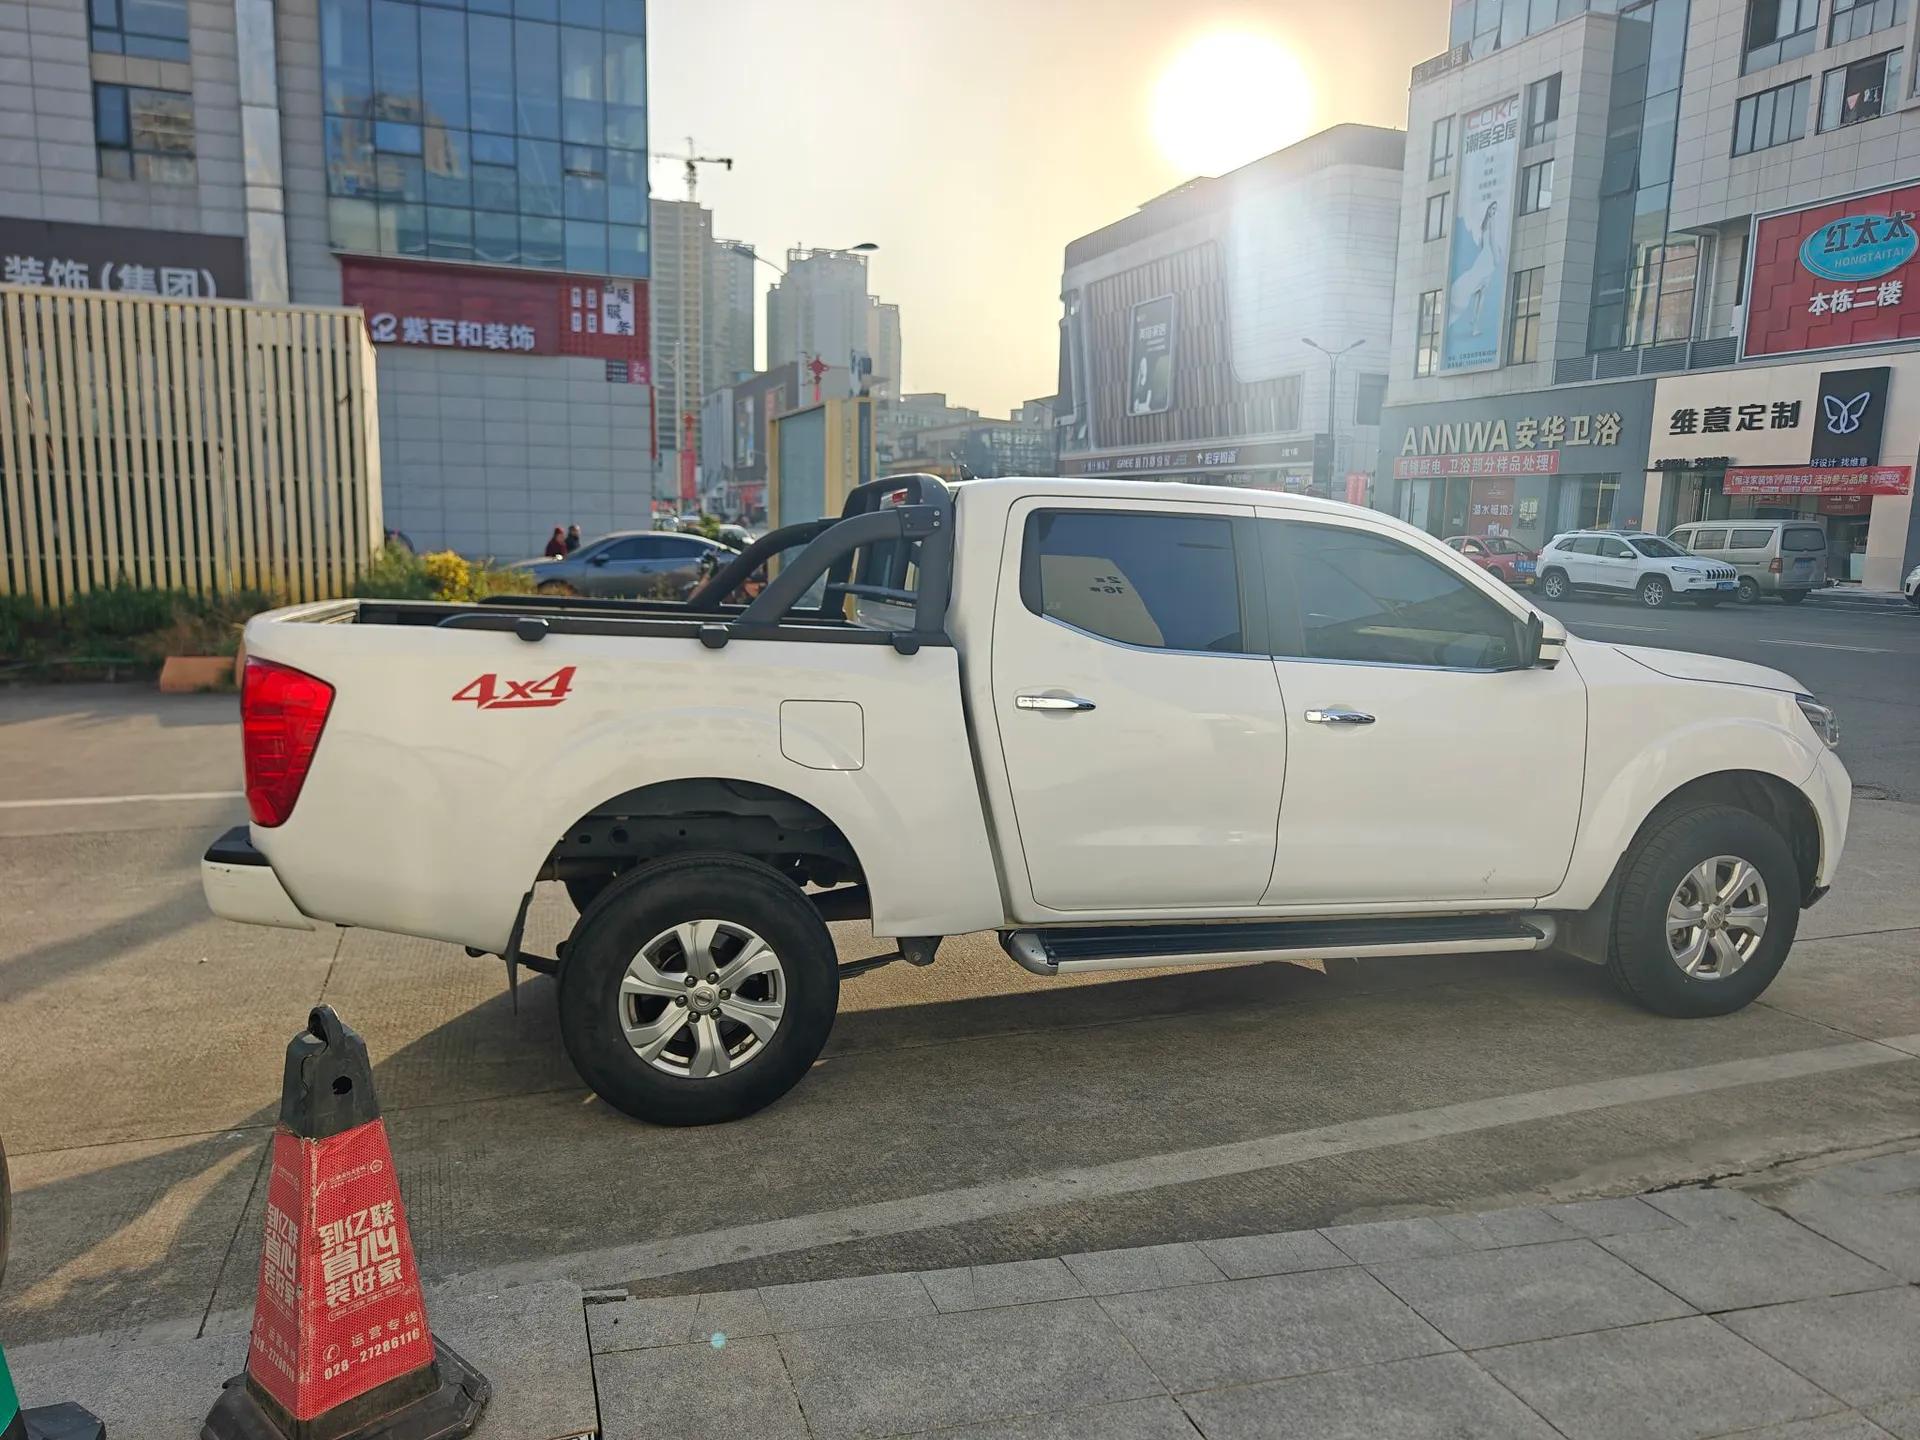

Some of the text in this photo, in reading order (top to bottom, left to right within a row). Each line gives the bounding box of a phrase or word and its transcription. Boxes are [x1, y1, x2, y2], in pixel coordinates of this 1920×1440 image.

[1824, 211, 1915, 253] 红太太
[1808, 281, 1903, 315] 本栋二楼
[403, 316, 536, 351] 紫百和装饰
[1515, 412, 1623, 449] 安华卫浴
[1669, 400, 1802, 435] 维意定制
[1401, 419, 1511, 457] ANNWA
[318, 1200, 396, 1250] 到亿联
[321, 1226, 400, 1282] 省心
[325, 1258, 403, 1308] 装好家
